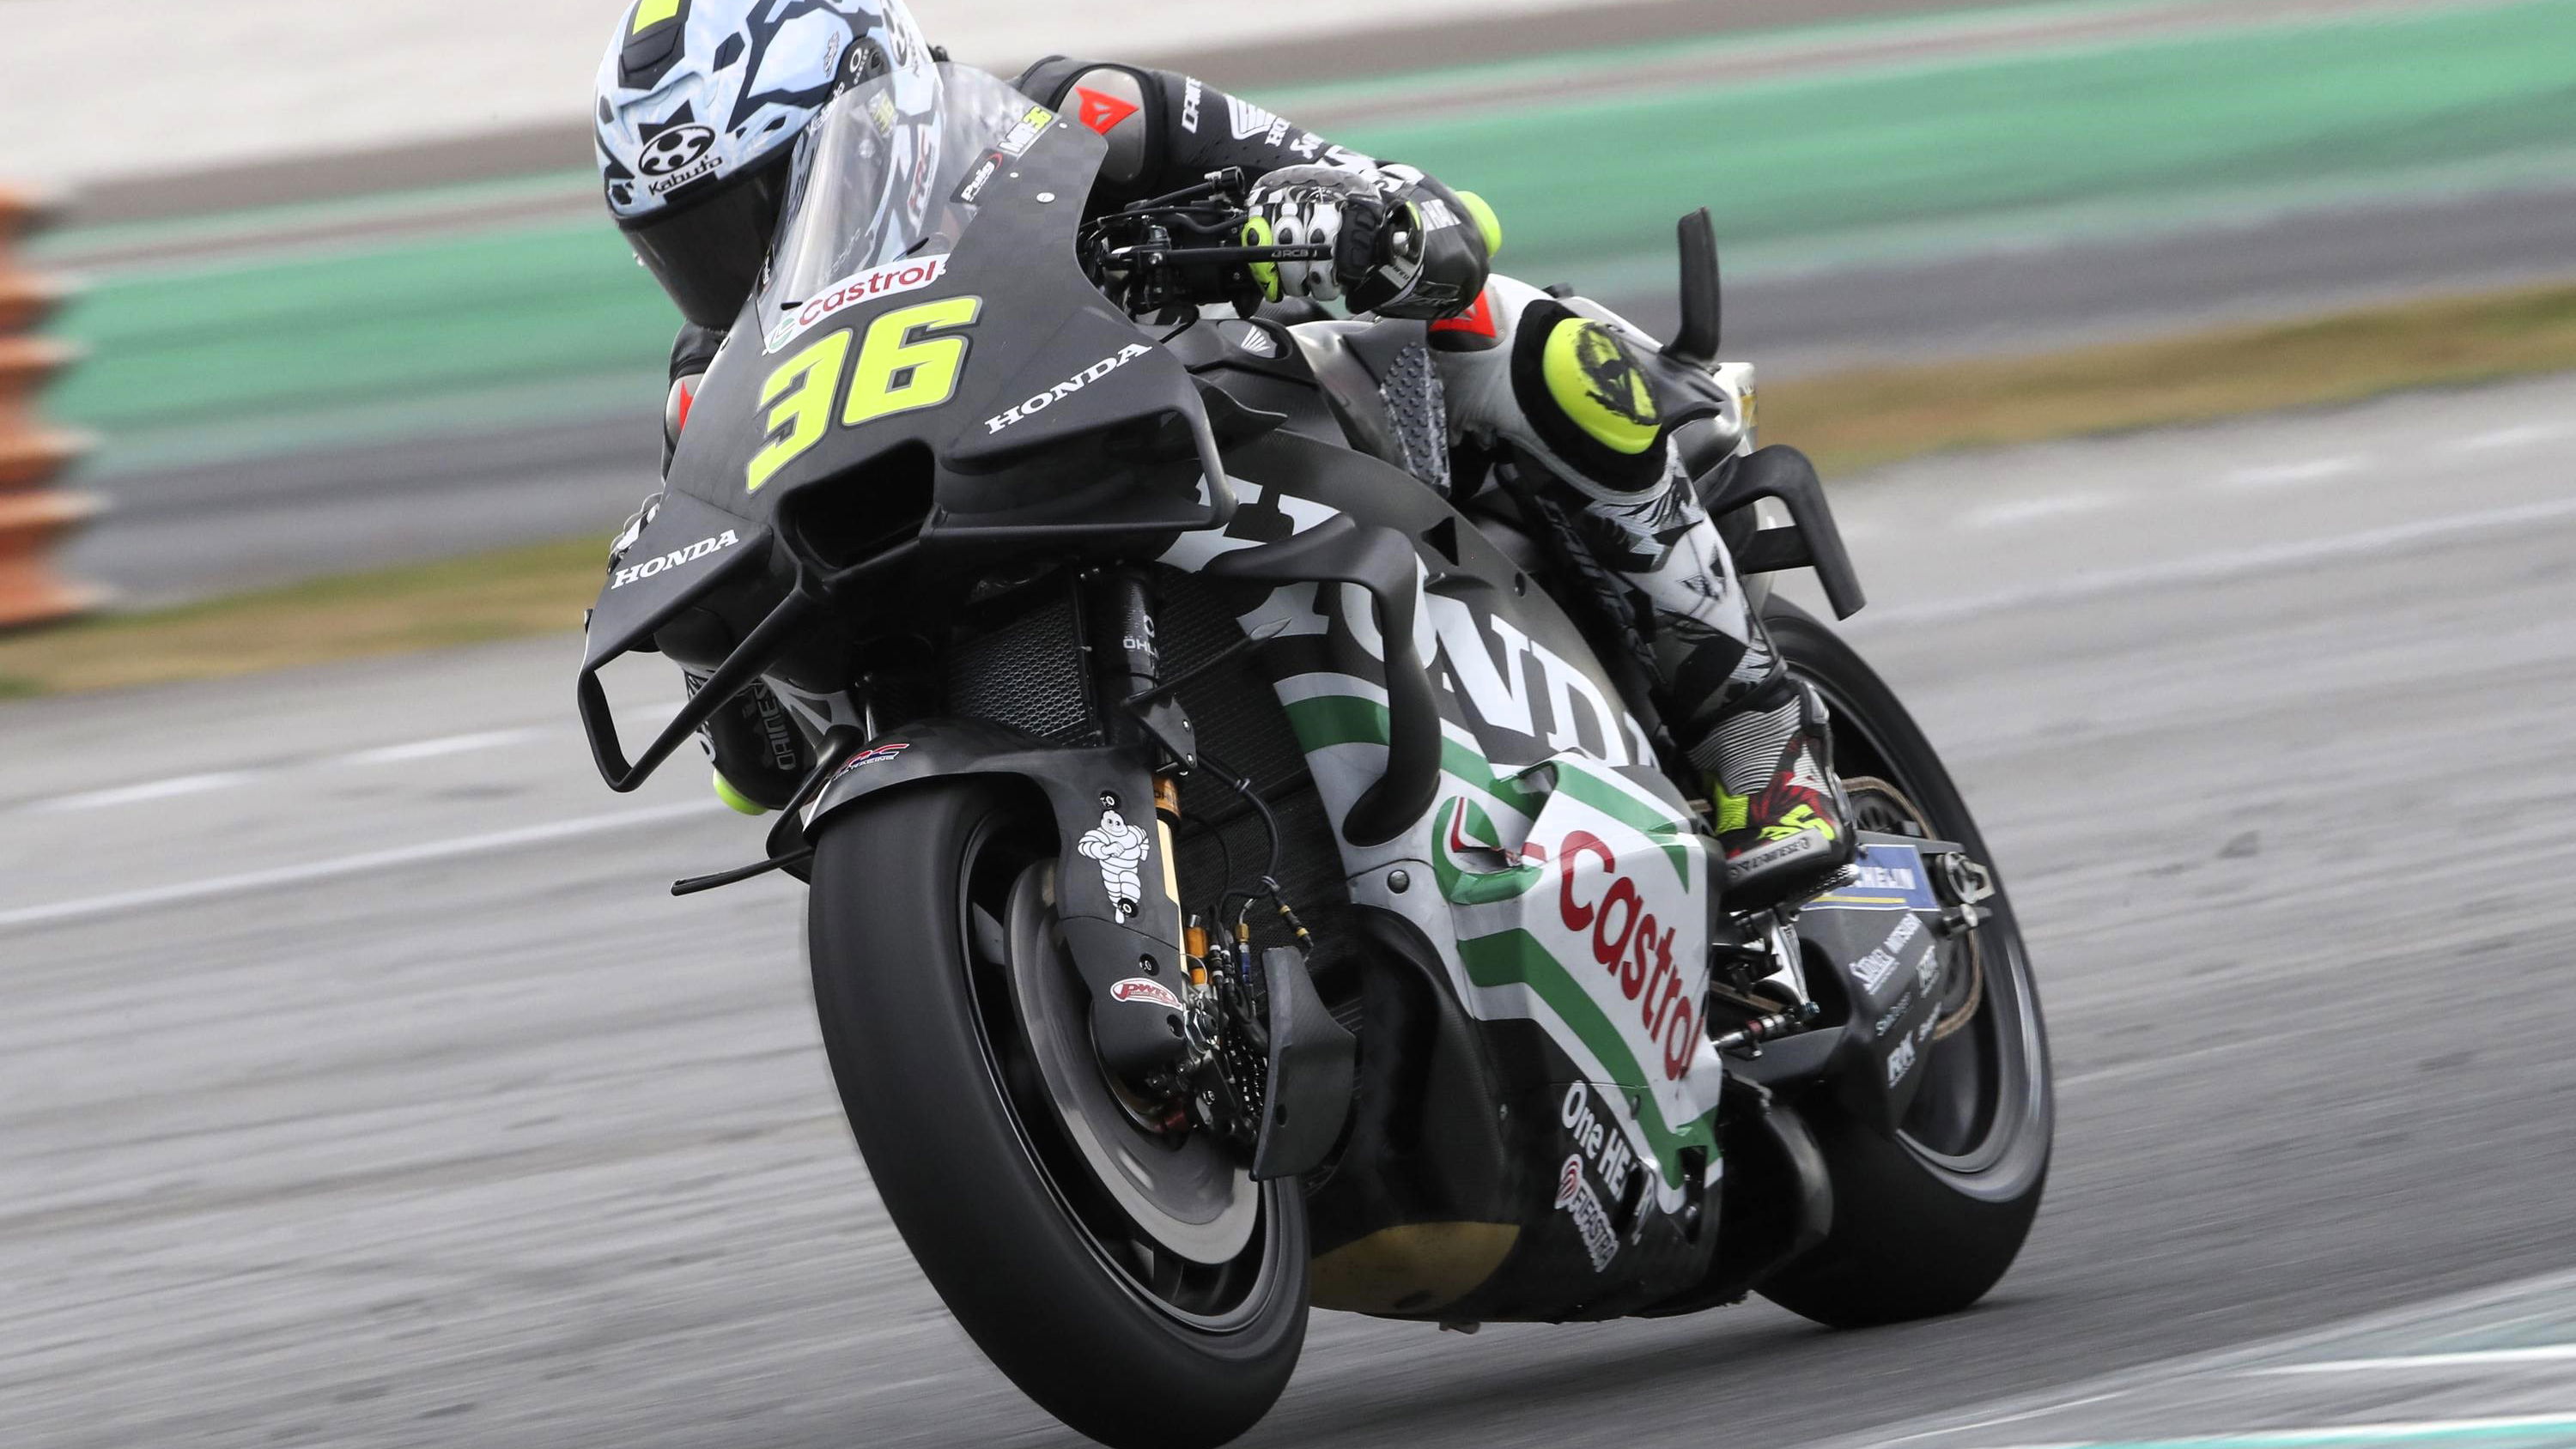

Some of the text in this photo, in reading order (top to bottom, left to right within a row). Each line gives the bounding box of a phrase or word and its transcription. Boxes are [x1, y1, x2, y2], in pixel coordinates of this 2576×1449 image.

[648, 155, 723, 196] Kabuto
[961, 161, 995, 201] Puig
[799, 260, 937, 326] Castrol
[745, 295, 983, 494] 36
[984, 343, 1152, 434] HONDA
[611, 529, 739, 590] HONDA
[1559, 830, 1704, 1081] Castrol
[1562, 1080, 1604, 1160] One
